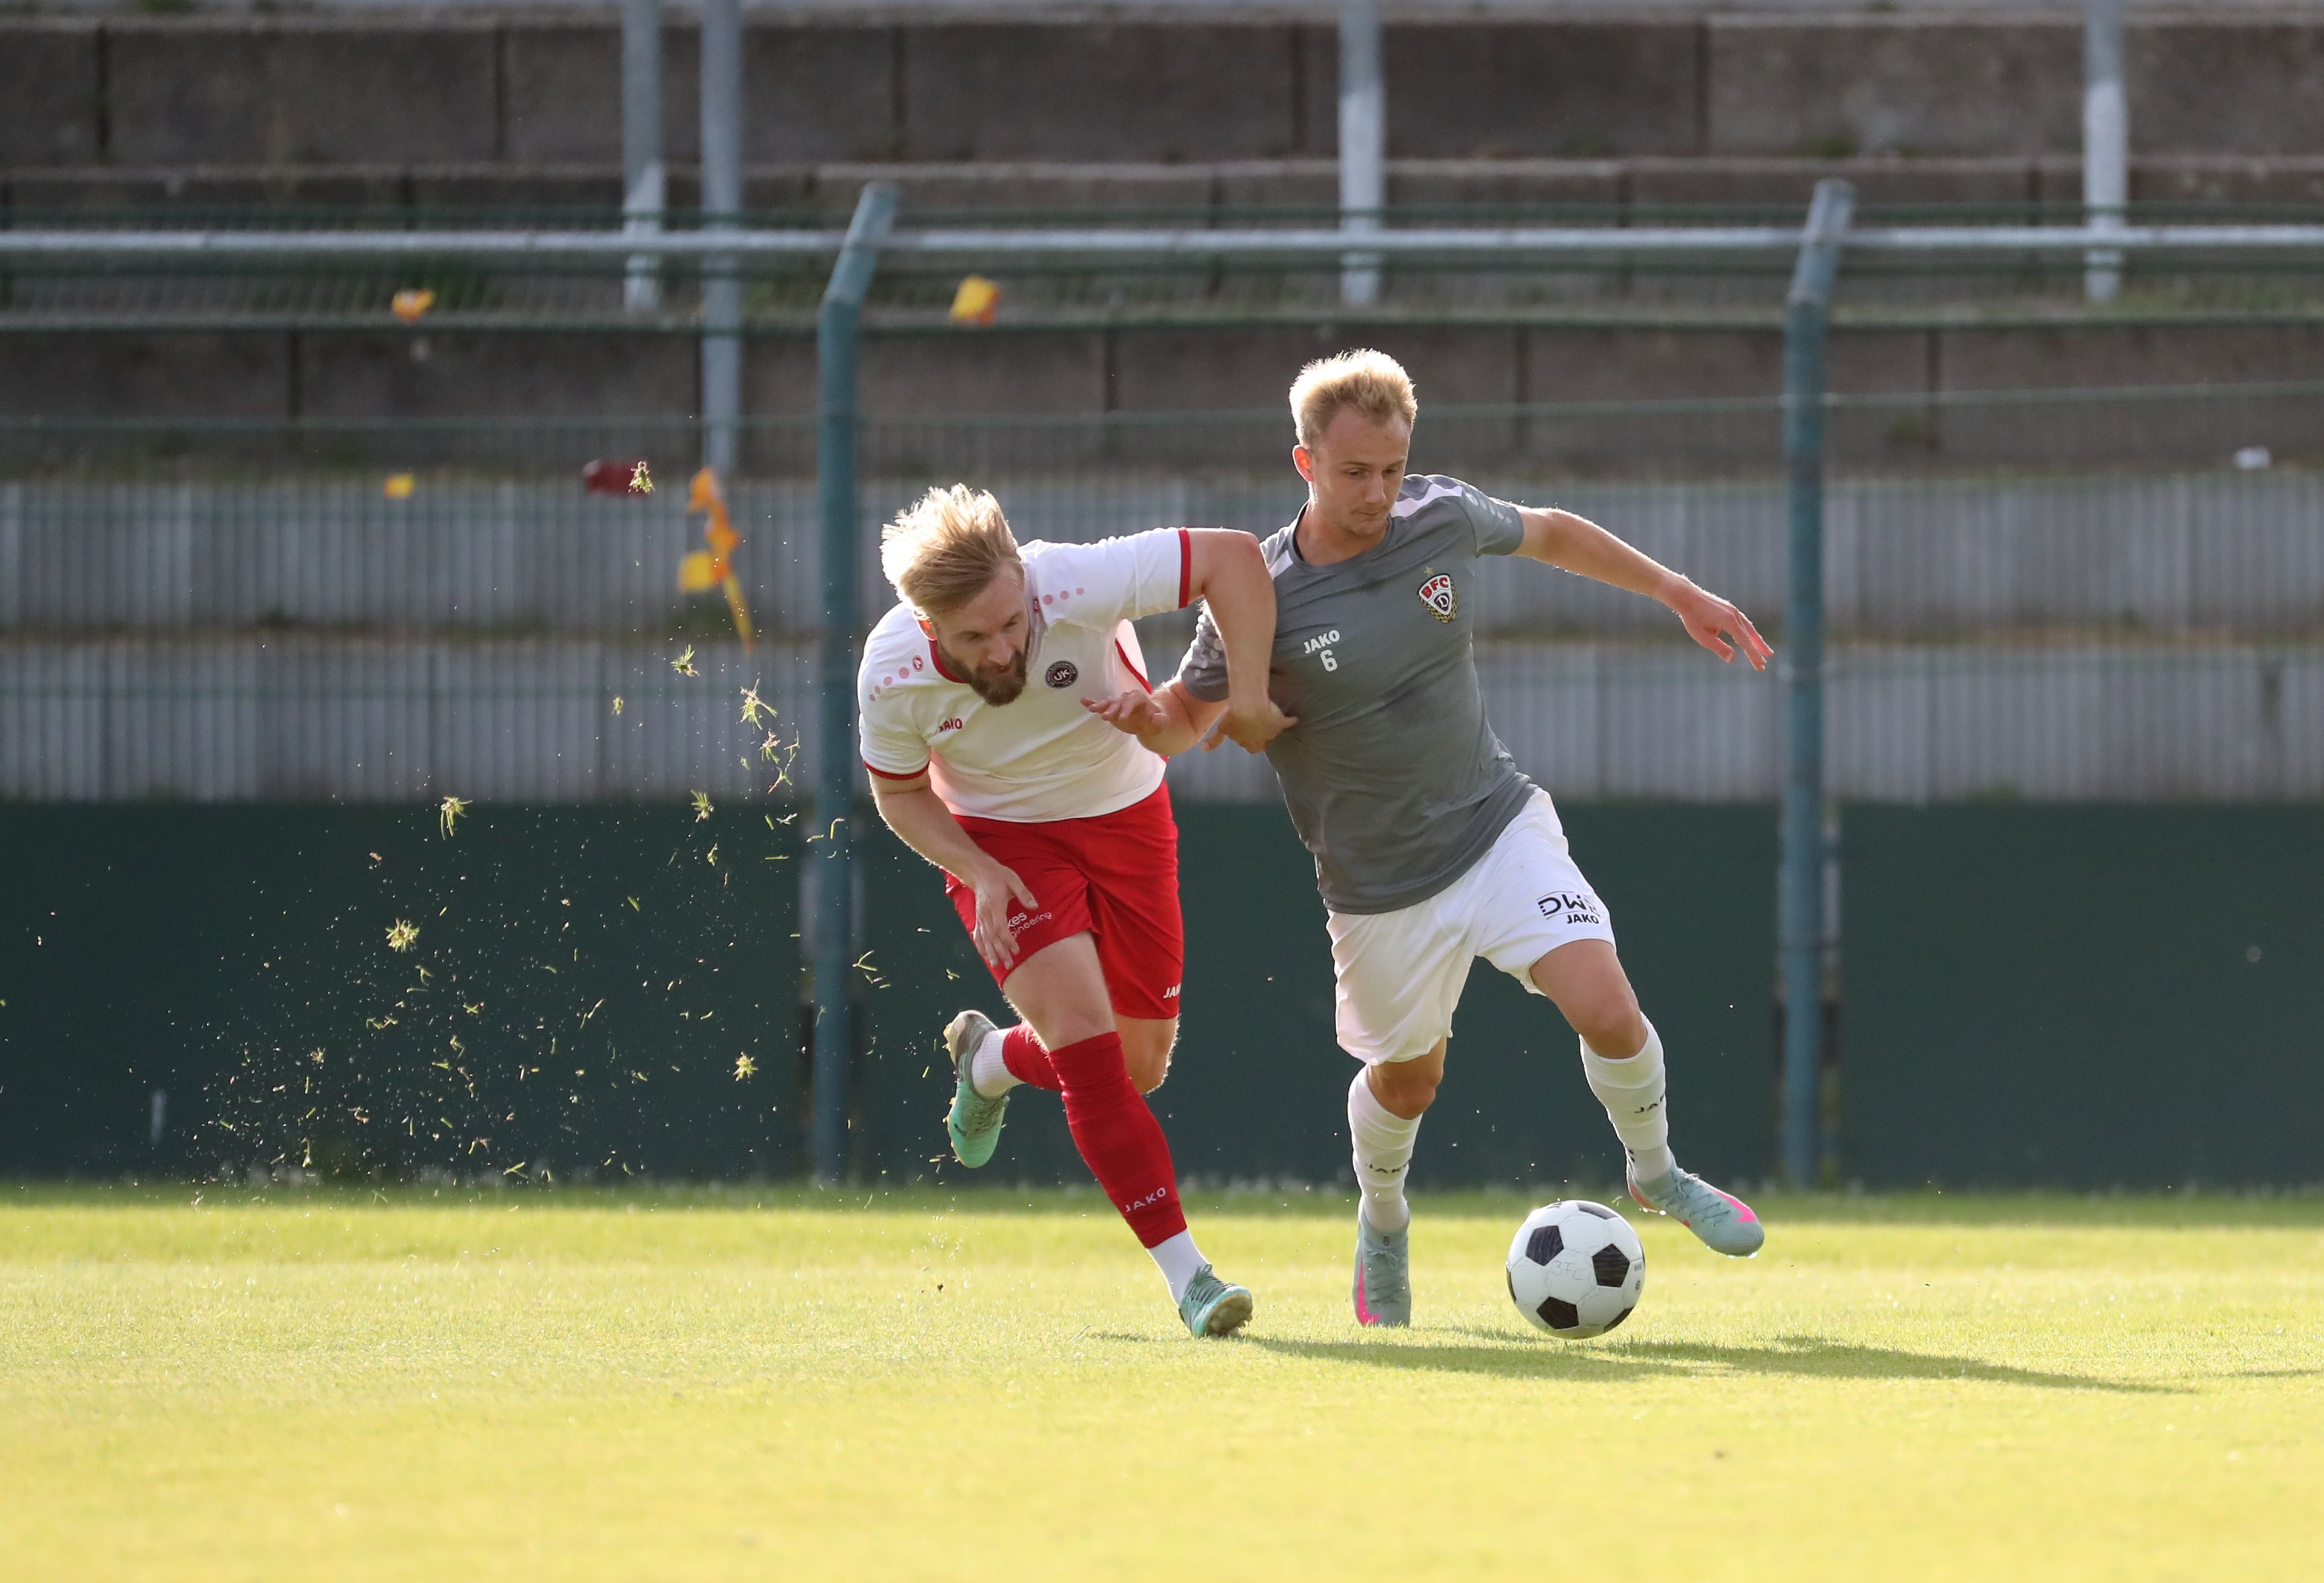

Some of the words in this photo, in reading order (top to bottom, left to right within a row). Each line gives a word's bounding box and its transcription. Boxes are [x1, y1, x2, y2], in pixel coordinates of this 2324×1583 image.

[1421, 576, 1449, 599] BFC
[1304, 630, 1340, 654] JAKO
[1320, 649, 1337, 672] 6
[1010, 911, 1052, 939] gineering
[1567, 914, 1599, 924] JAKO
[1162, 982, 1181, 999] JAK
[1125, 1187, 1166, 1212] JAKO
